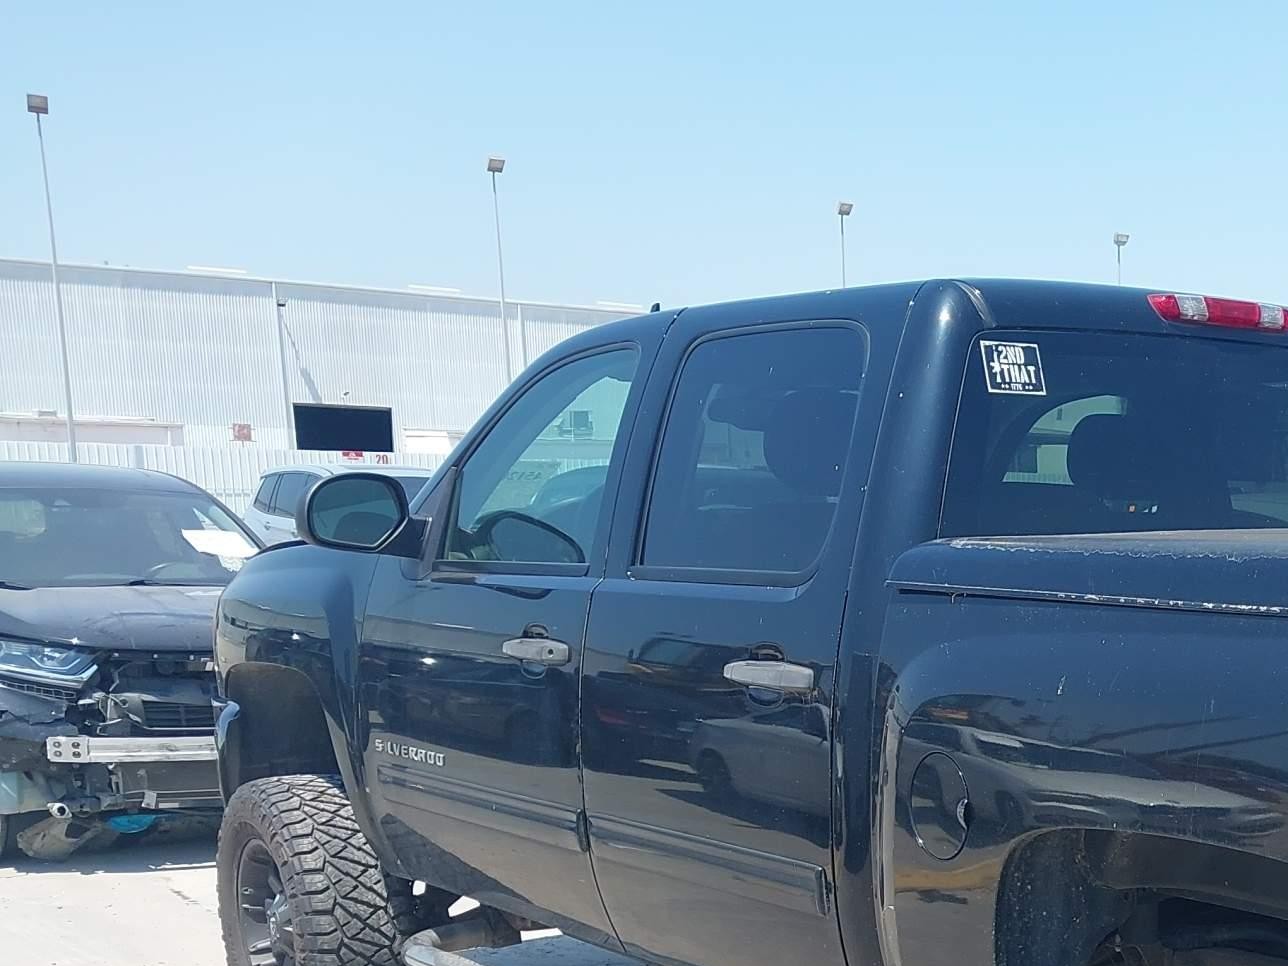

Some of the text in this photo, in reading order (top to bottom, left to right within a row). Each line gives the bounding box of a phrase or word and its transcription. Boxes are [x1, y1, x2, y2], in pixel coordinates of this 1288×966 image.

[998, 346, 1025, 365] 2ND
[1001, 364, 1036, 384] THAT
[375, 739, 445, 767] SILVERADO
